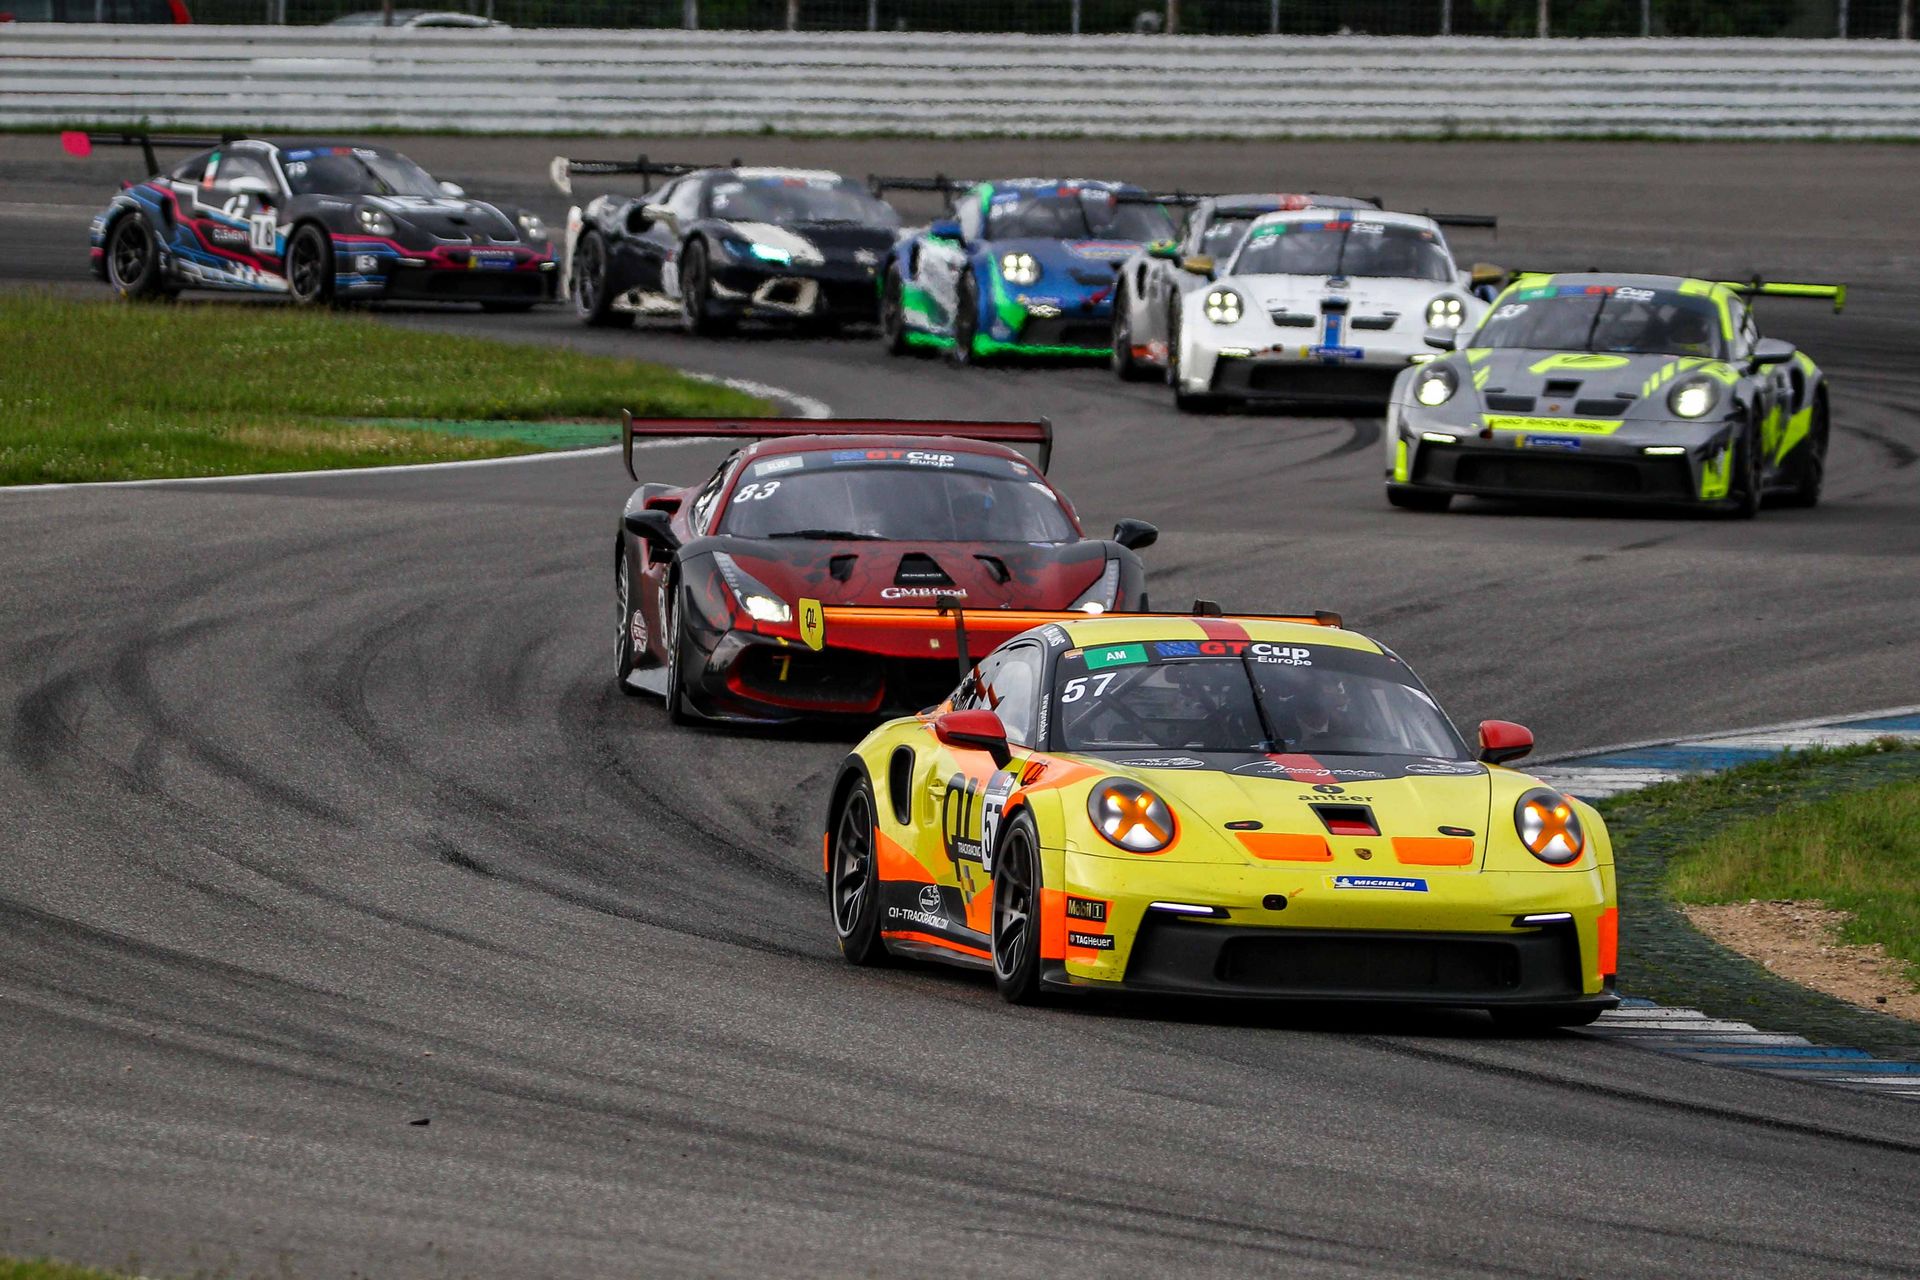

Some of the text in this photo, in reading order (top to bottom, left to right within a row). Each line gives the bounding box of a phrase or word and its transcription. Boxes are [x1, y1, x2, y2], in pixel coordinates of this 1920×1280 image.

[253, 221, 273, 246] 78
[1615, 286, 1655, 297] Cup
[866, 450, 907, 460] GT
[907, 451, 955, 463] Cup
[734, 481, 781, 503] 83
[1106, 641, 1310, 662] AM GT Cup
[1257, 655, 1312, 667] Europe
[1061, 672, 1118, 703] 57
[984, 802, 1003, 859] 57
[1353, 879, 1416, 888] MICHELIN
[1068, 899, 1092, 917] Mobil
